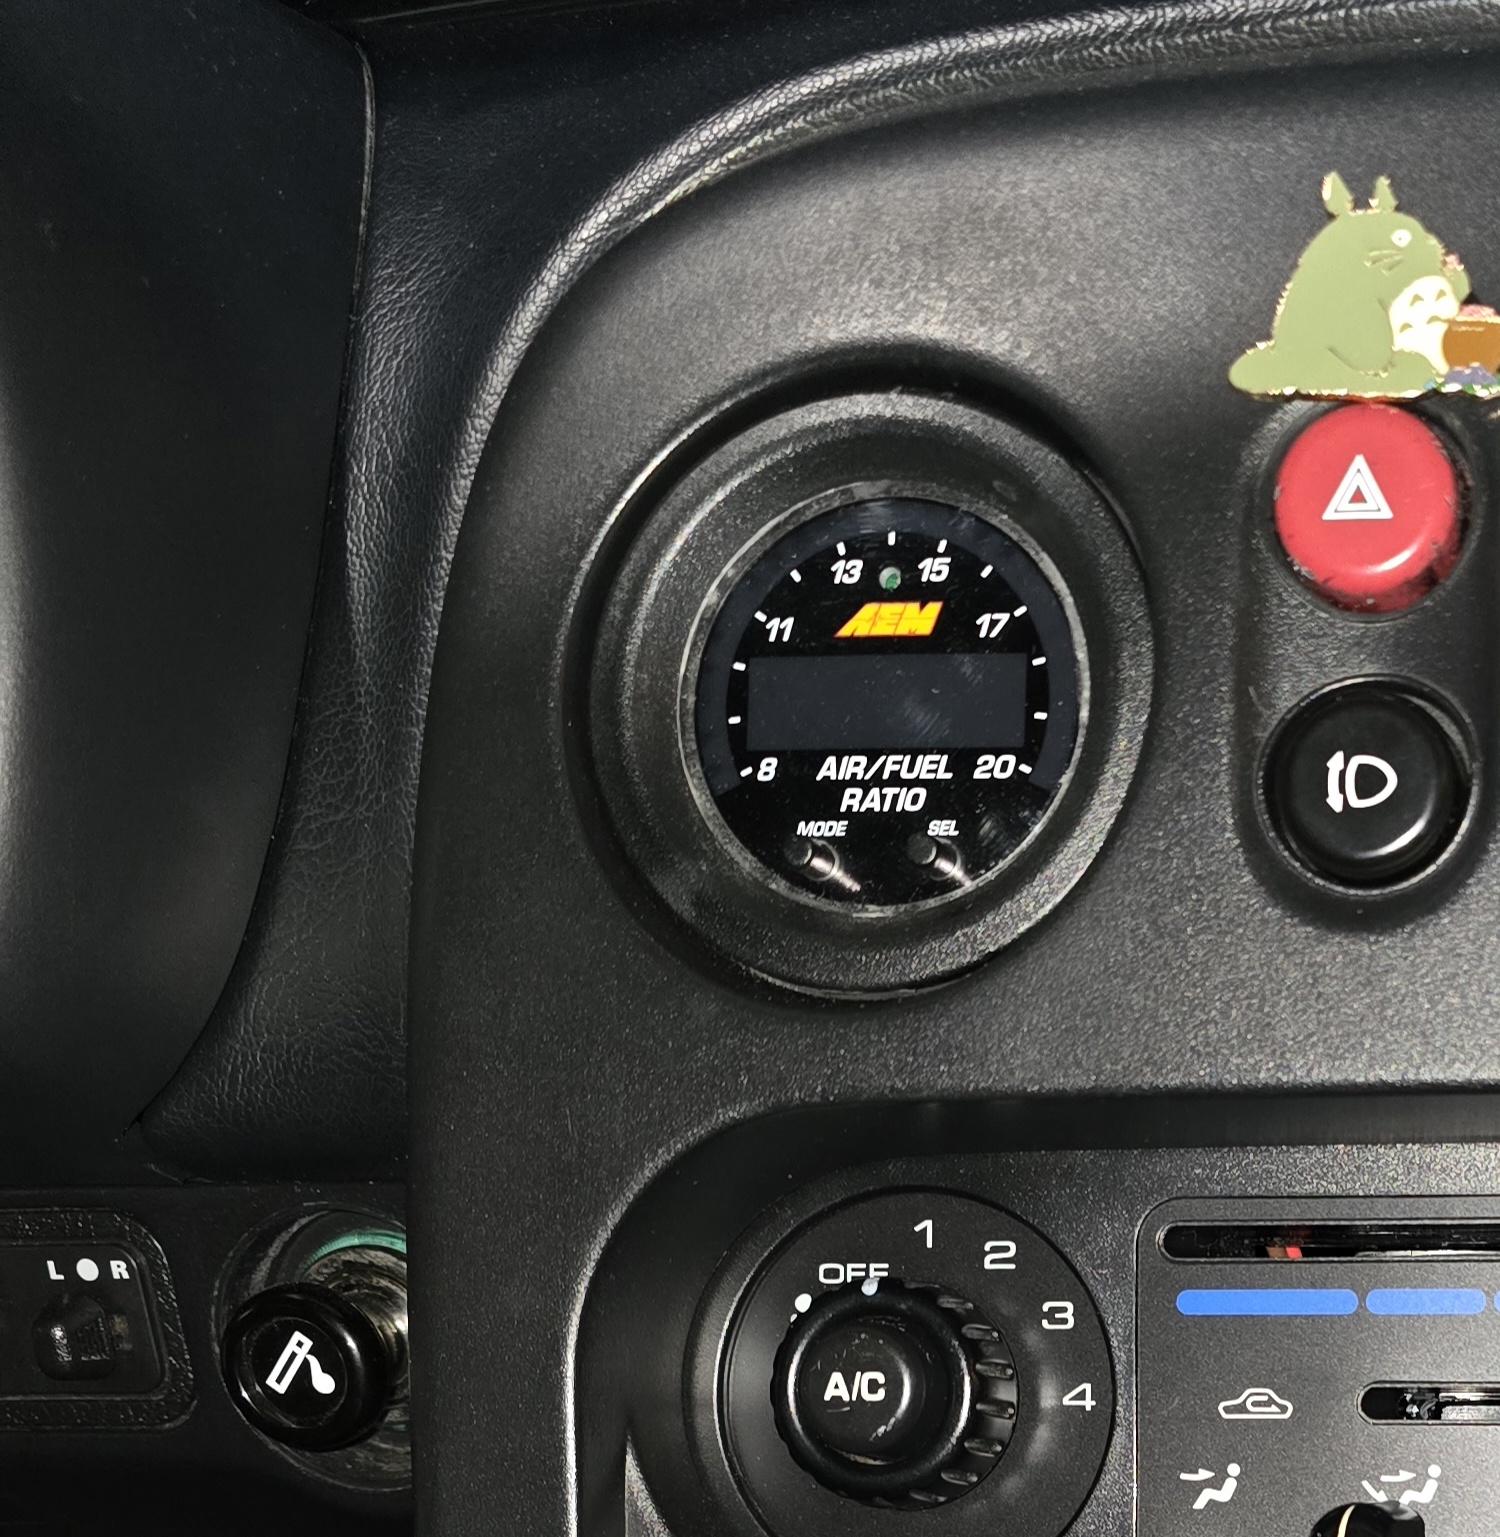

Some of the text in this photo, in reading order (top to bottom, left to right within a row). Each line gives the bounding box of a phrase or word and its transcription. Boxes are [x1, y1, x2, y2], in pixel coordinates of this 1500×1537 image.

[830, 560, 862, 584] 13
[917, 557, 950, 582] 15
[765, 617, 793, 642] 11
[834, 601, 943, 637] AEM
[975, 613, 1009, 638] 17
[756, 757, 777, 782] 8
[816, 755, 953, 781] AIR/FUEL
[972, 755, 1015, 780] 20
[840, 788, 926, 813] RATIO
[797, 820, 848, 837] MODE
[927, 820, 959, 837] SEL
[913, 1219, 933, 1248] 1
[983, 1240, 1016, 1269] 2
[47, 1261, 64, 1280] L
[110, 1261, 129, 1279] R
[1041, 1301, 1074, 1329] 3
[823, 1371, 885, 1401] A/C
[1062, 1383, 1096, 1410] 4
